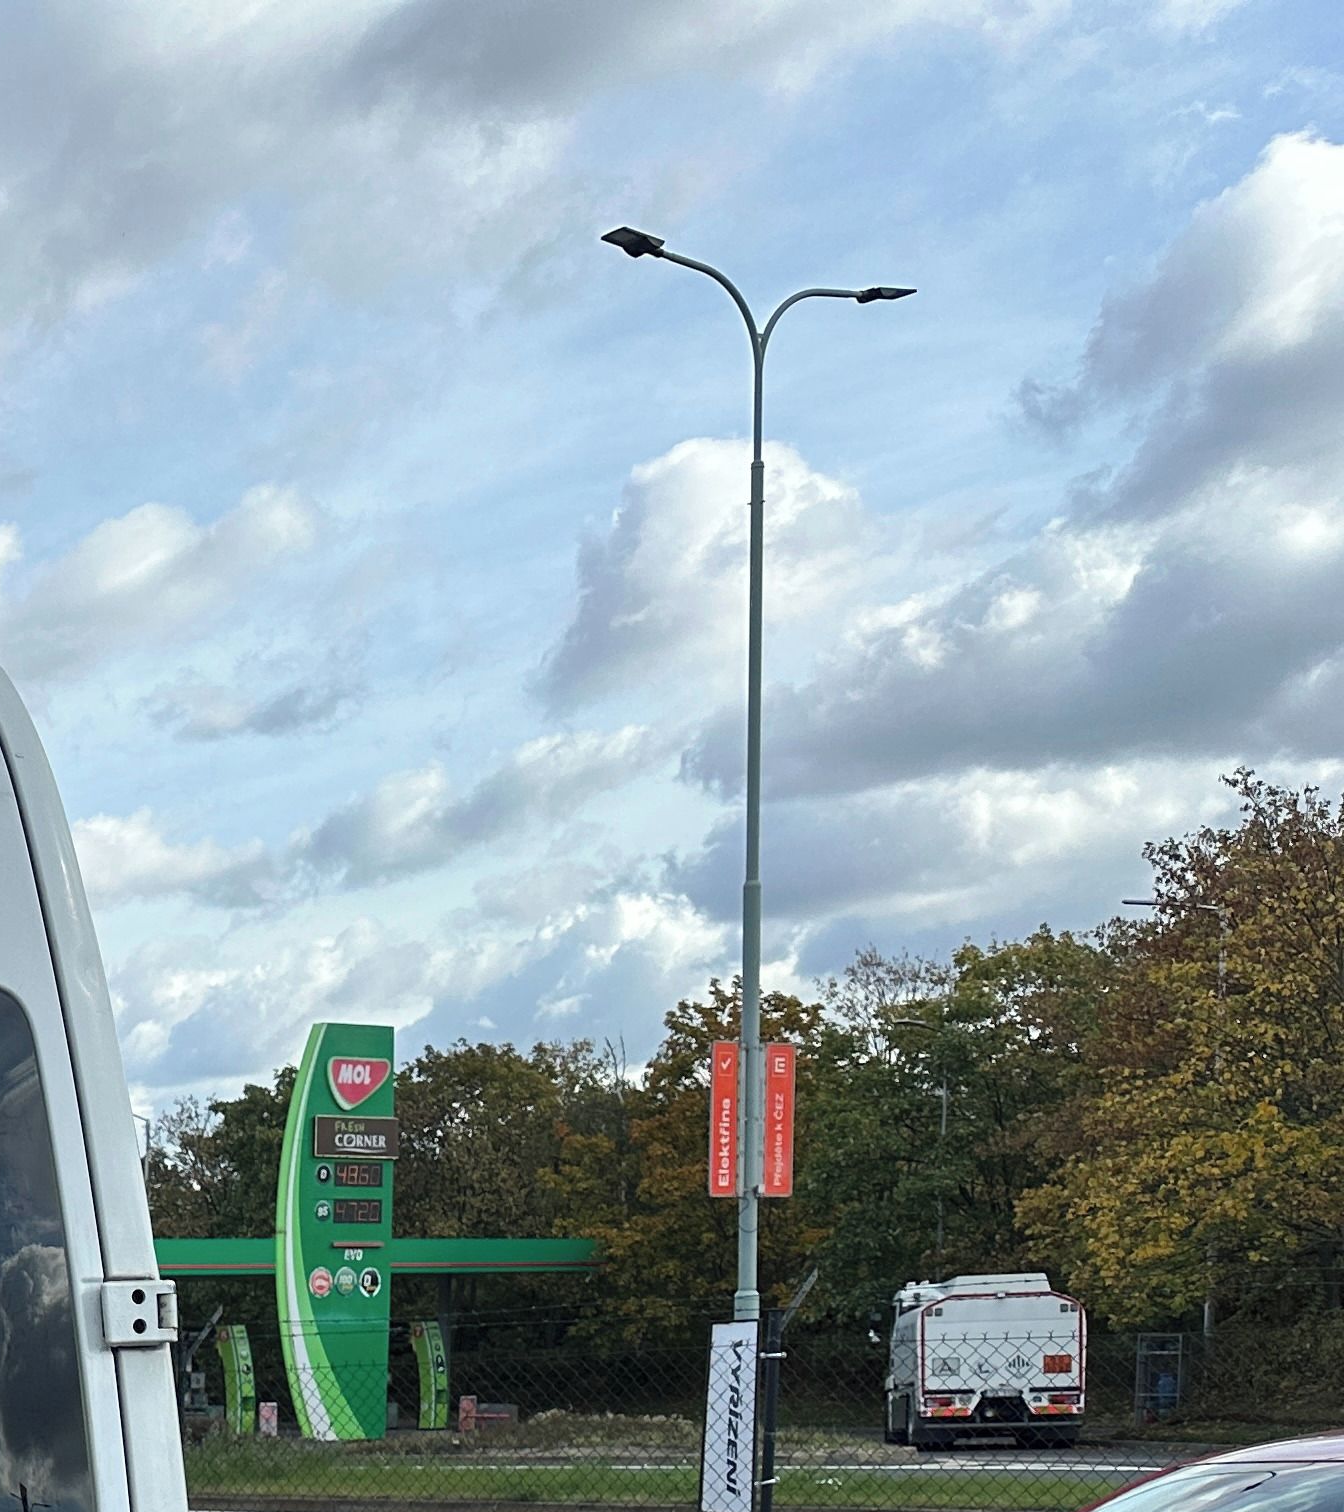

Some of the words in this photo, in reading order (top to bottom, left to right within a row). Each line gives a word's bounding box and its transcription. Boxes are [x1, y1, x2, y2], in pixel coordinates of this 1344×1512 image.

[338, 1063, 371, 1085] MOL
[773, 1092, 785, 1121] ČEZ
[775, 1123, 783, 1131] k
[334, 1133, 386, 1148] CORNER
[717, 1098, 731, 1187] Elektřina
[726, 1339, 744, 1498] VYŘÍZENÍ
